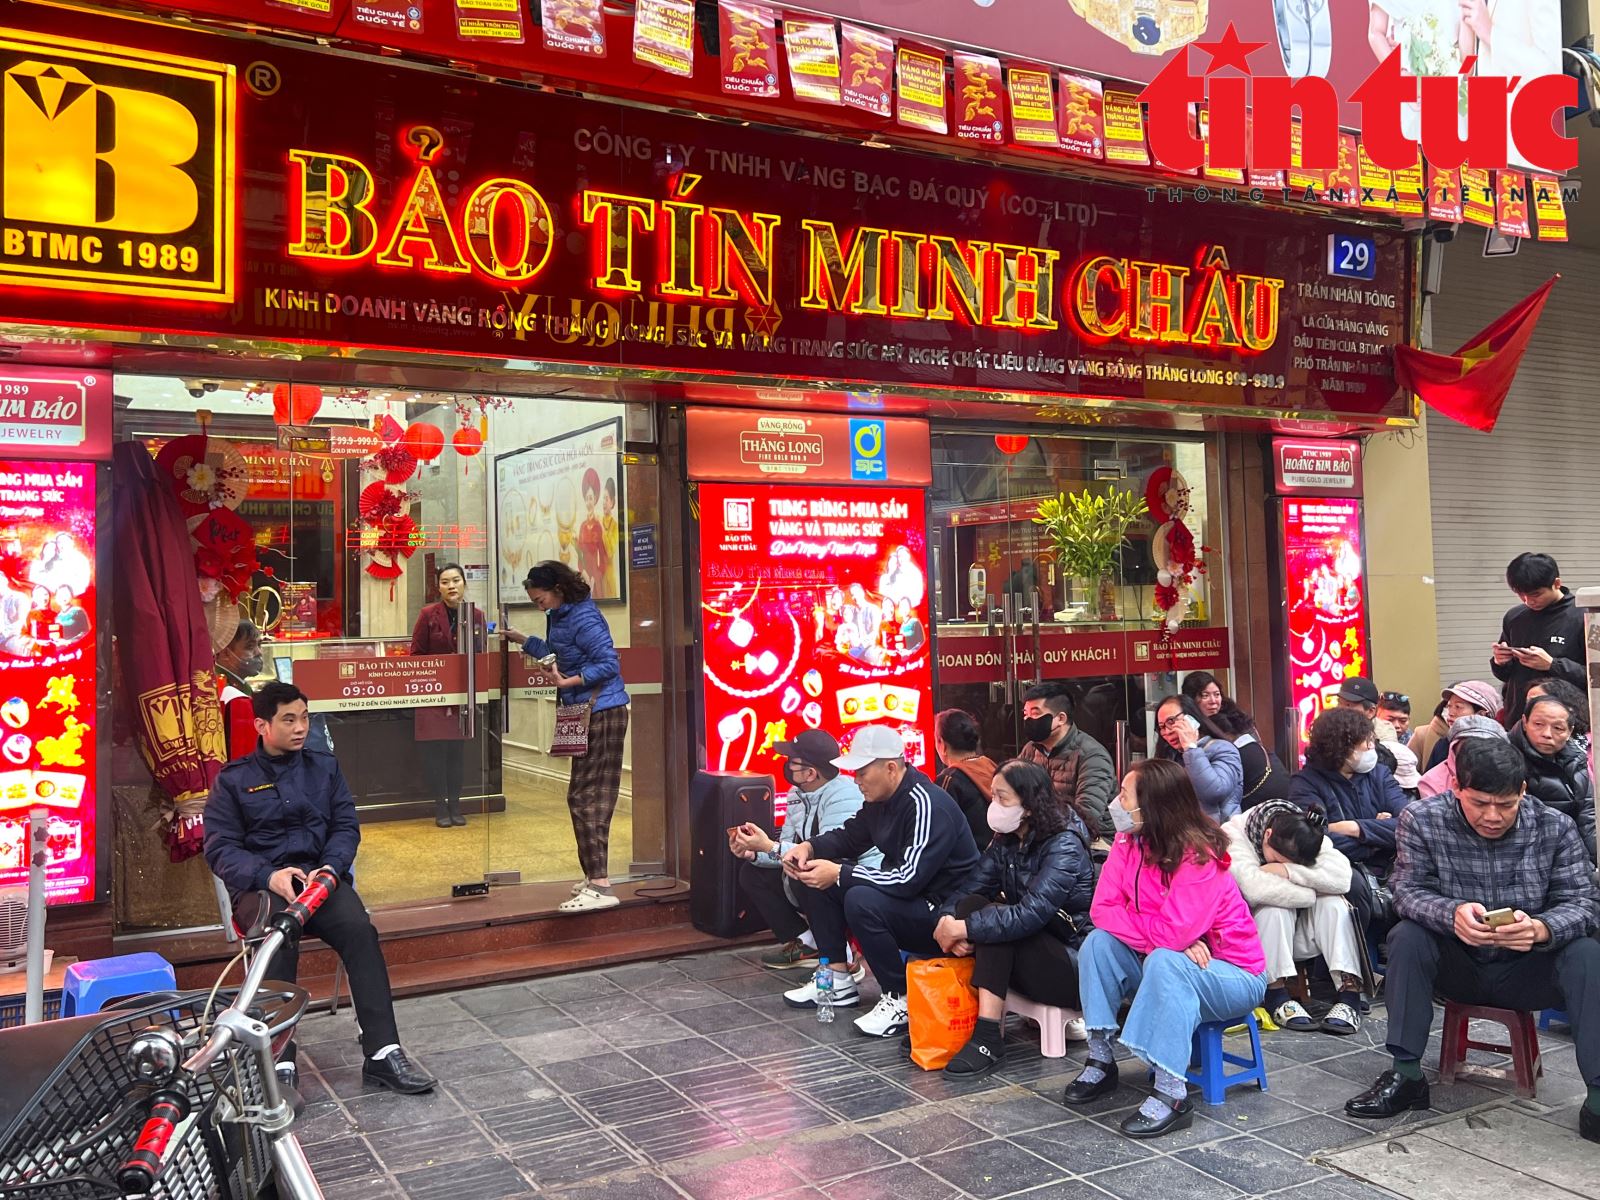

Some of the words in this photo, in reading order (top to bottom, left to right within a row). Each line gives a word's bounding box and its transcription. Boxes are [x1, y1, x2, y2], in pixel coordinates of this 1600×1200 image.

[356, 6, 375, 15] TIÊU
[376, 8, 406, 20] CHUẨN
[356, 14, 388, 25] QUỐC
[392, 18, 406, 28] TẾ
[546, 32, 563, 42] TIÊU
[546, 40, 574, 50] QUỐC
[577, 44, 590, 52] TẾ
[724, 82, 750, 92] QUỐC
[752, 84, 764, 92] TẾ
[725, 76, 740, 84] TIÊU
[741, 76, 764, 86] CHUẨN
[844, 96, 866, 106] QUỐC
[868, 100, 878, 110] TẾ
[985, 132, 992, 140] TẾ
[1060, 144, 1080, 152] QUỐC
[1082, 146, 1091, 154] TẾ
[574, 125, 650, 160] CÔNG
[704, 148, 770, 179] TNHH
[854, 170, 900, 199] BẠC
[908, 177, 938, 202] ĐÁ
[945, 182, 990, 210] QUÝ
[288, 125, 555, 281] BẢO
[582, 172, 781, 306] TÍN
[800, 219, 1060, 330] MINH
[1075, 244, 1285, 351] CHÂU
[4, 228, 102, 264] BTMC
[118, 240, 199, 273] 1989
[1340, 240, 1369, 271] 29
[1364, 290, 1396, 308] TÔNG
[265, 288, 319, 313] KINH
[326, 292, 406, 321] DOANH
[414, 298, 472, 326] VÀNG
[478, 304, 537, 332] RỒNG
[542, 312, 608, 340] THĂNG
[790, 338, 844, 358] TRANG
[848, 338, 880, 362] SỨC
[908, 345, 950, 367] NGHỆ
[952, 346, 990, 369] CHẤT
[993, 351, 1024, 374] LIỆU
[1146, 362, 1189, 382] THĂNG
[1190, 368, 1224, 385] LONG
[1359, 342, 1384, 355] BTMC
[31, 396, 78, 420] BẢO
[760, 421, 781, 430] VÀNG
[782, 422, 803, 430] RỒNG
[1, 428, 62, 439] JEWELRY
[743, 438, 785, 452] THĂNG
[788, 441, 820, 454] LONG
[243, 456, 276, 466] MINH
[280, 456, 312, 467] CHÂU
[1315, 458, 1331, 471] KIM
[24, 474, 54, 487] MUA
[56, 470, 83, 488] SẮM
[810, 498, 848, 518] BỪNG
[850, 502, 878, 518] MUA
[880, 498, 908, 519] SẮM
[770, 520, 803, 536] VÀNG
[805, 520, 820, 536] VÀ
[822, 522, 861, 537] TRANG
[1183, 641, 1200, 649] MINH
[976, 651, 1001, 666] ĐÓN
[1044, 648, 1068, 663] QUÝ
[1071, 648, 1110, 662] KHÁCH
[1113, 649, 1117, 659] !
[359, 660, 377, 670] BẢO
[379, 660, 394, 669] TÍN
[396, 661, 420, 669] MINH
[421, 658, 446, 668] CHÂU
[368, 670, 383, 678] KÍNH
[528, 676, 554, 685] 09:
[343, 686, 385, 696] 09:00
[405, 683, 442, 693] 19:00
[348, 700, 360, 708] THỨ
